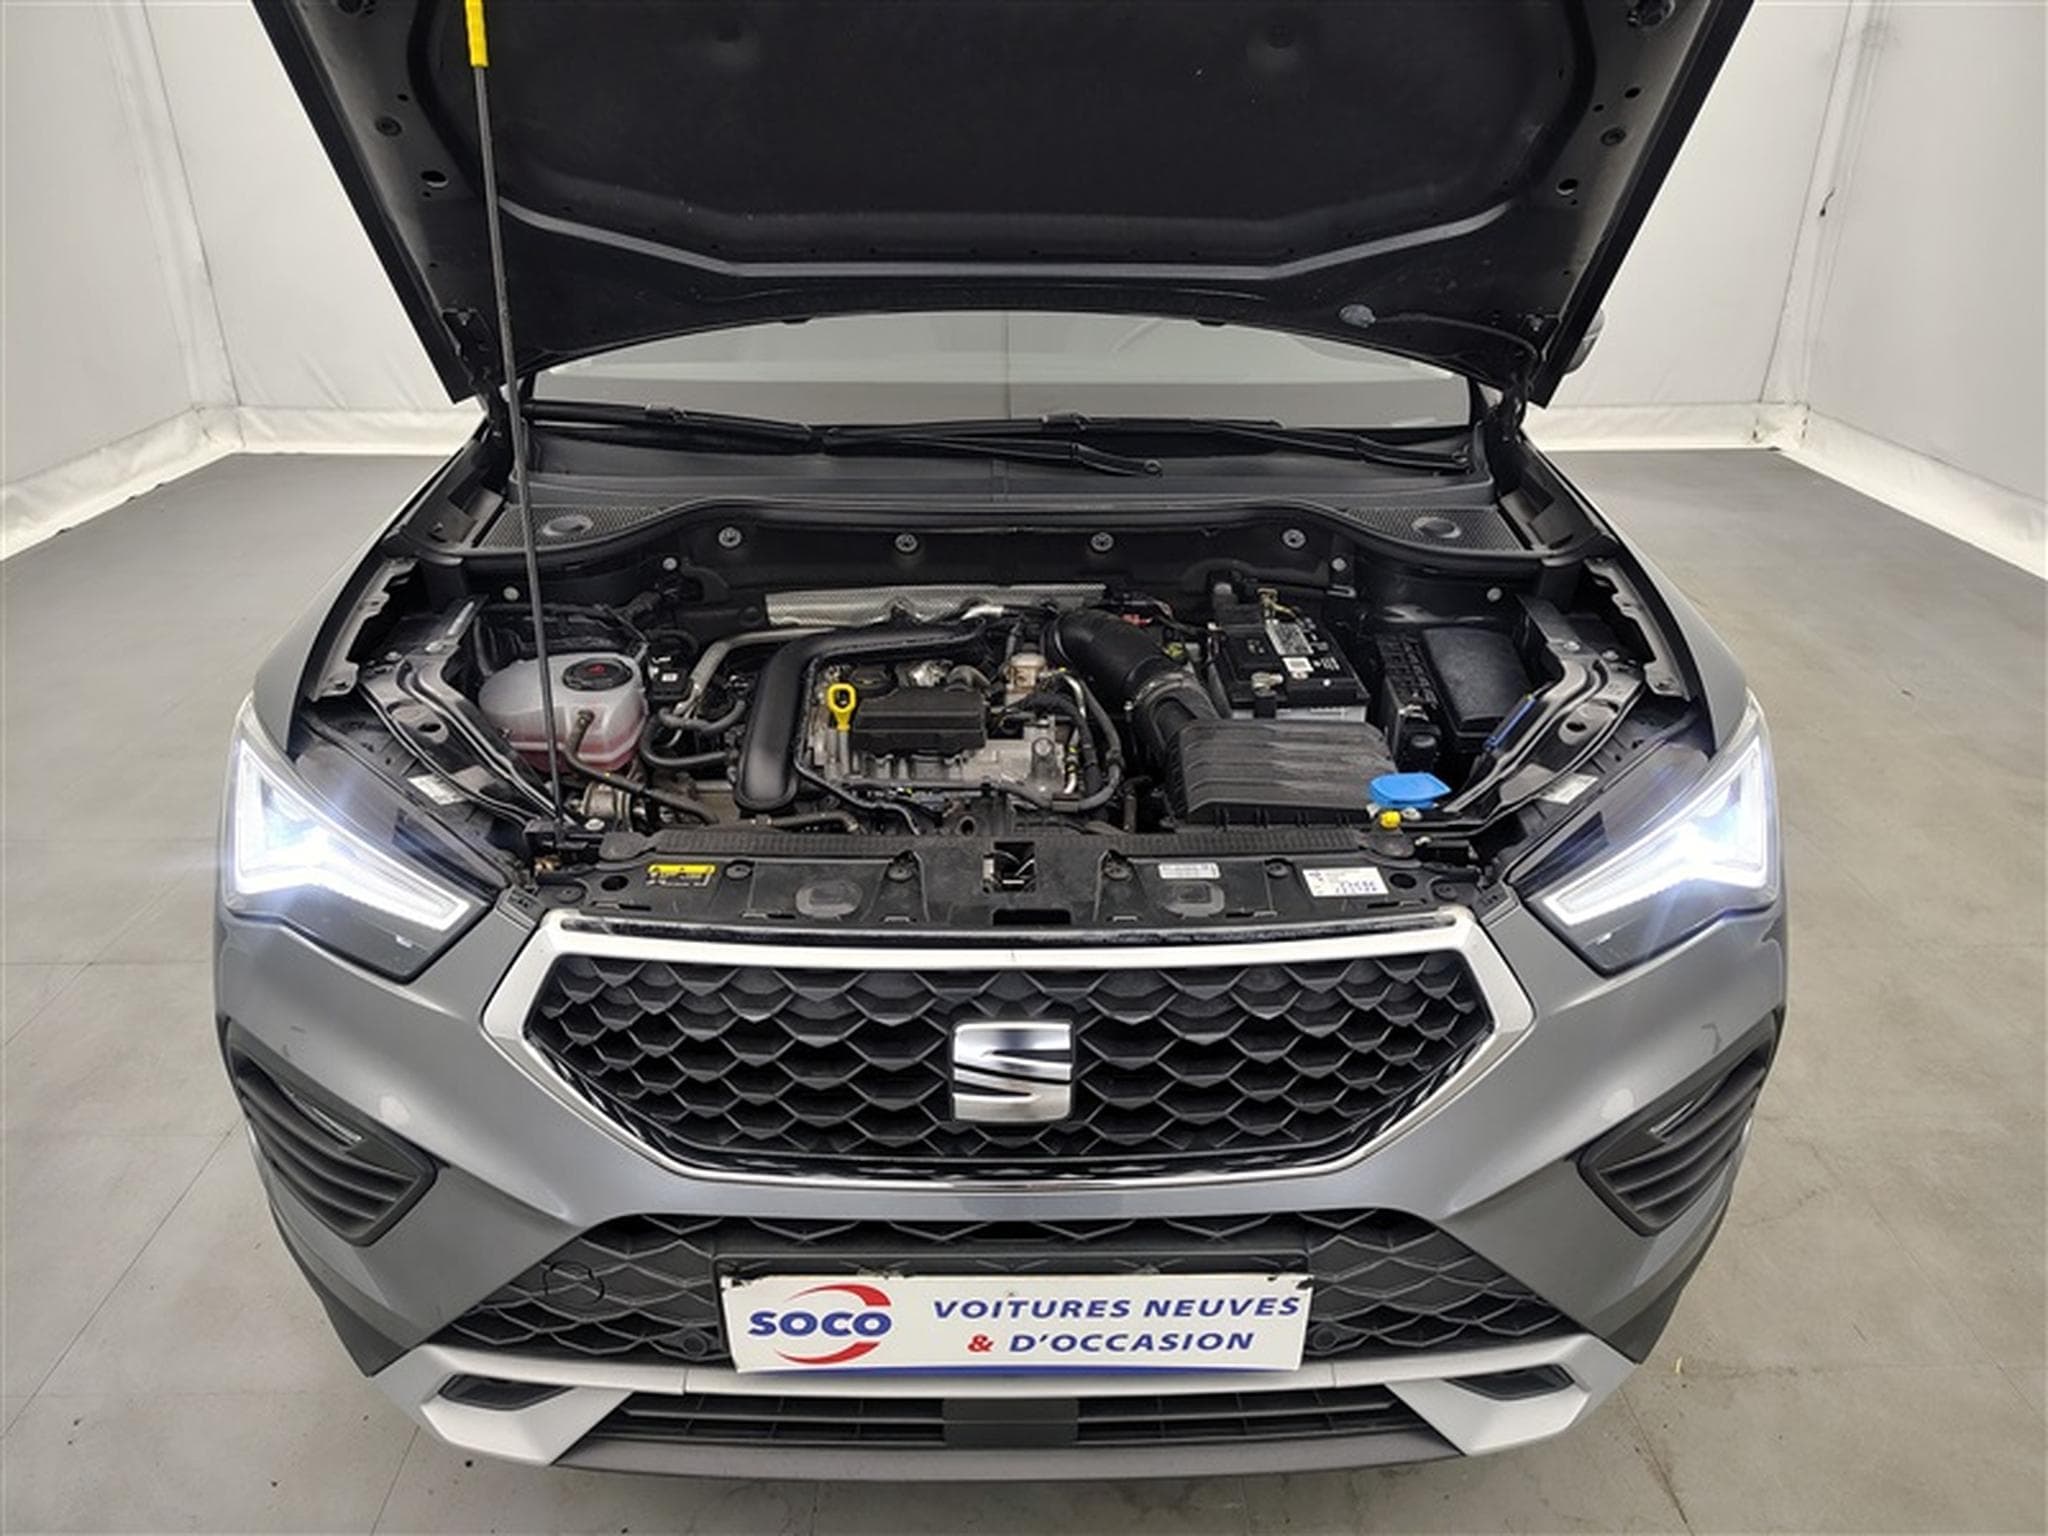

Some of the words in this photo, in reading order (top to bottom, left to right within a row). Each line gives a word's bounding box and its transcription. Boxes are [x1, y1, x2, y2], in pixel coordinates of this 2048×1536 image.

[933, 1299, 1131, 1319] VOITURES
[1143, 1297, 1300, 1318] NEUVES
[747, 1309, 893, 1338] SOCO
[967, 1333, 994, 1354] &
[1009, 1331, 1255, 1353] D'OCCASION
